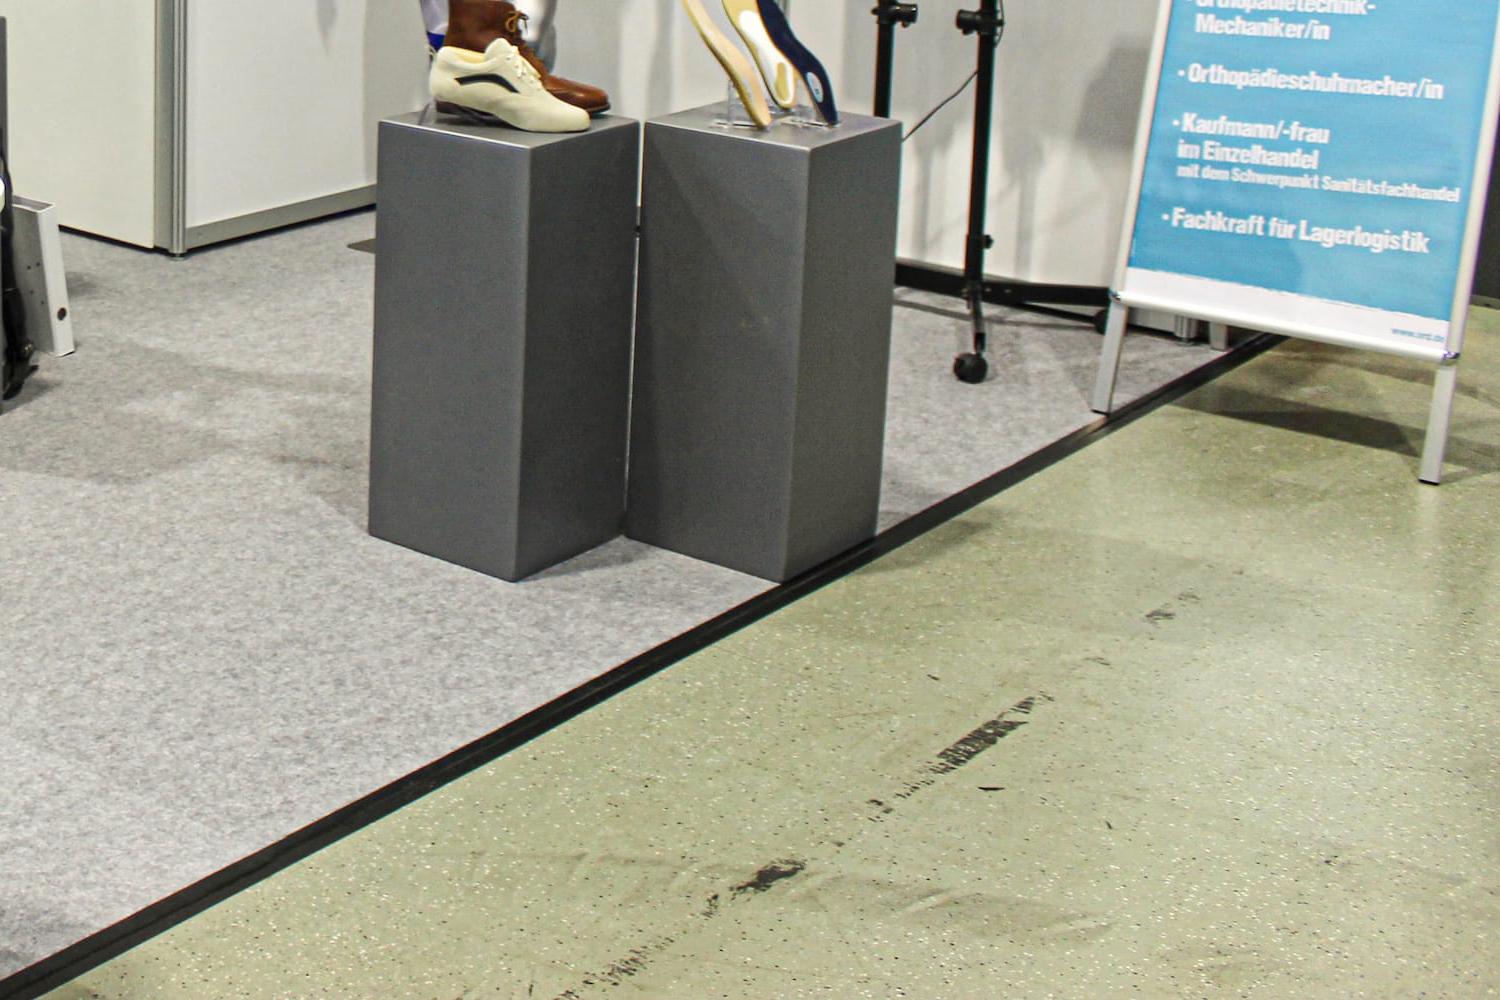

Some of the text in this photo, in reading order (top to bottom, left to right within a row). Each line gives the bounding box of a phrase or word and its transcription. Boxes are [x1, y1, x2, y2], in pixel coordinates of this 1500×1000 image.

[1195, 13, 1331, 41] Mechaniker/in
[1188, 63, 1444, 99] Orthopädieschuhmacher/in
[1182, 112, 1330, 144] Kaufmann/-frau
[1177, 139, 1319, 170] im Einzelhandel
[1177, 164, 1199, 179] mit
[1202, 165, 1229, 180] dem
[1231, 168, 1319, 189] Schwerpunkt
[1172, 208, 1430, 253] Fachkraft für Lagerlogistik
